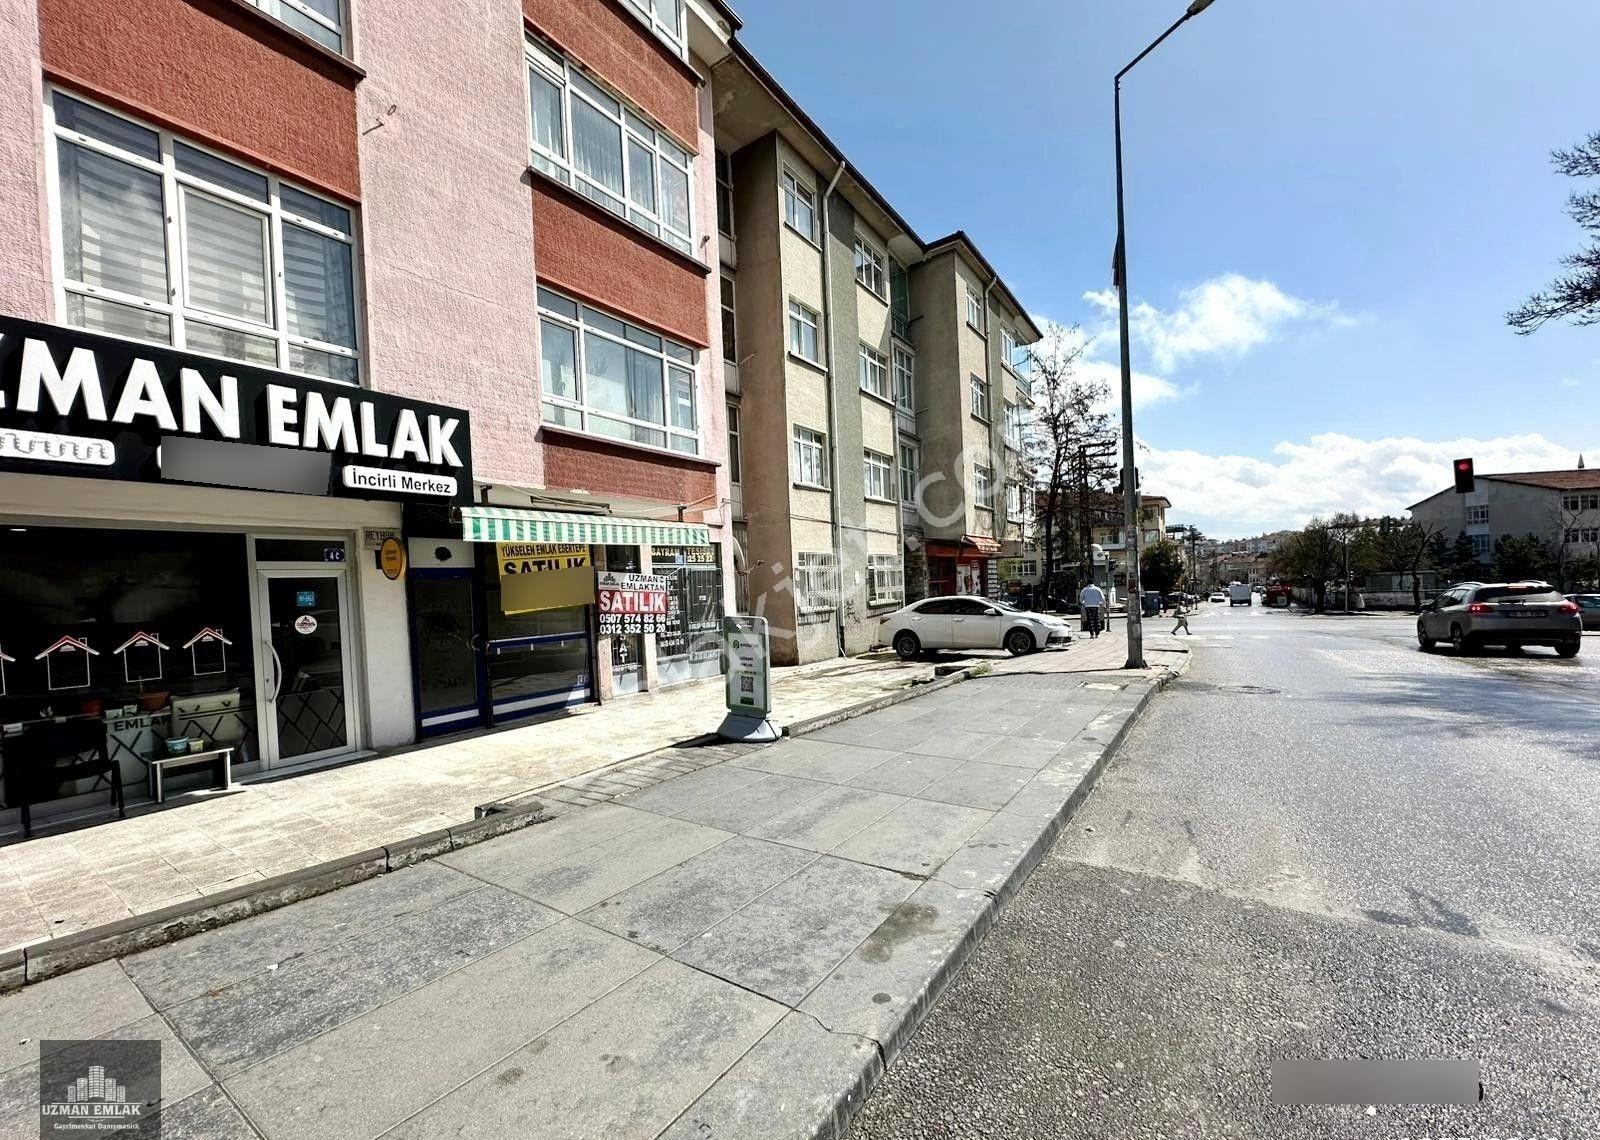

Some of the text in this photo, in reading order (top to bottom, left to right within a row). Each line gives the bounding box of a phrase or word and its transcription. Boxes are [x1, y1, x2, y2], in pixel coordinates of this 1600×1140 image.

[0, 333, 464, 467] MAN EMLAK
[352, 467, 451, 494] İncirli Merkez
[500, 543, 587, 557] YÜKSELEN EMLAK ESERTEPE
[628, 574, 658, 583] UZMAN
[620, 582, 665, 591] EMLAKTAN
[600, 590, 666, 612] SATILIK
[600, 613, 622, 624] 0507
[624, 613, 641, 623] 574
[643, 613, 655, 623] 82
[600, 623, 666, 635] 0312 352 50 20
